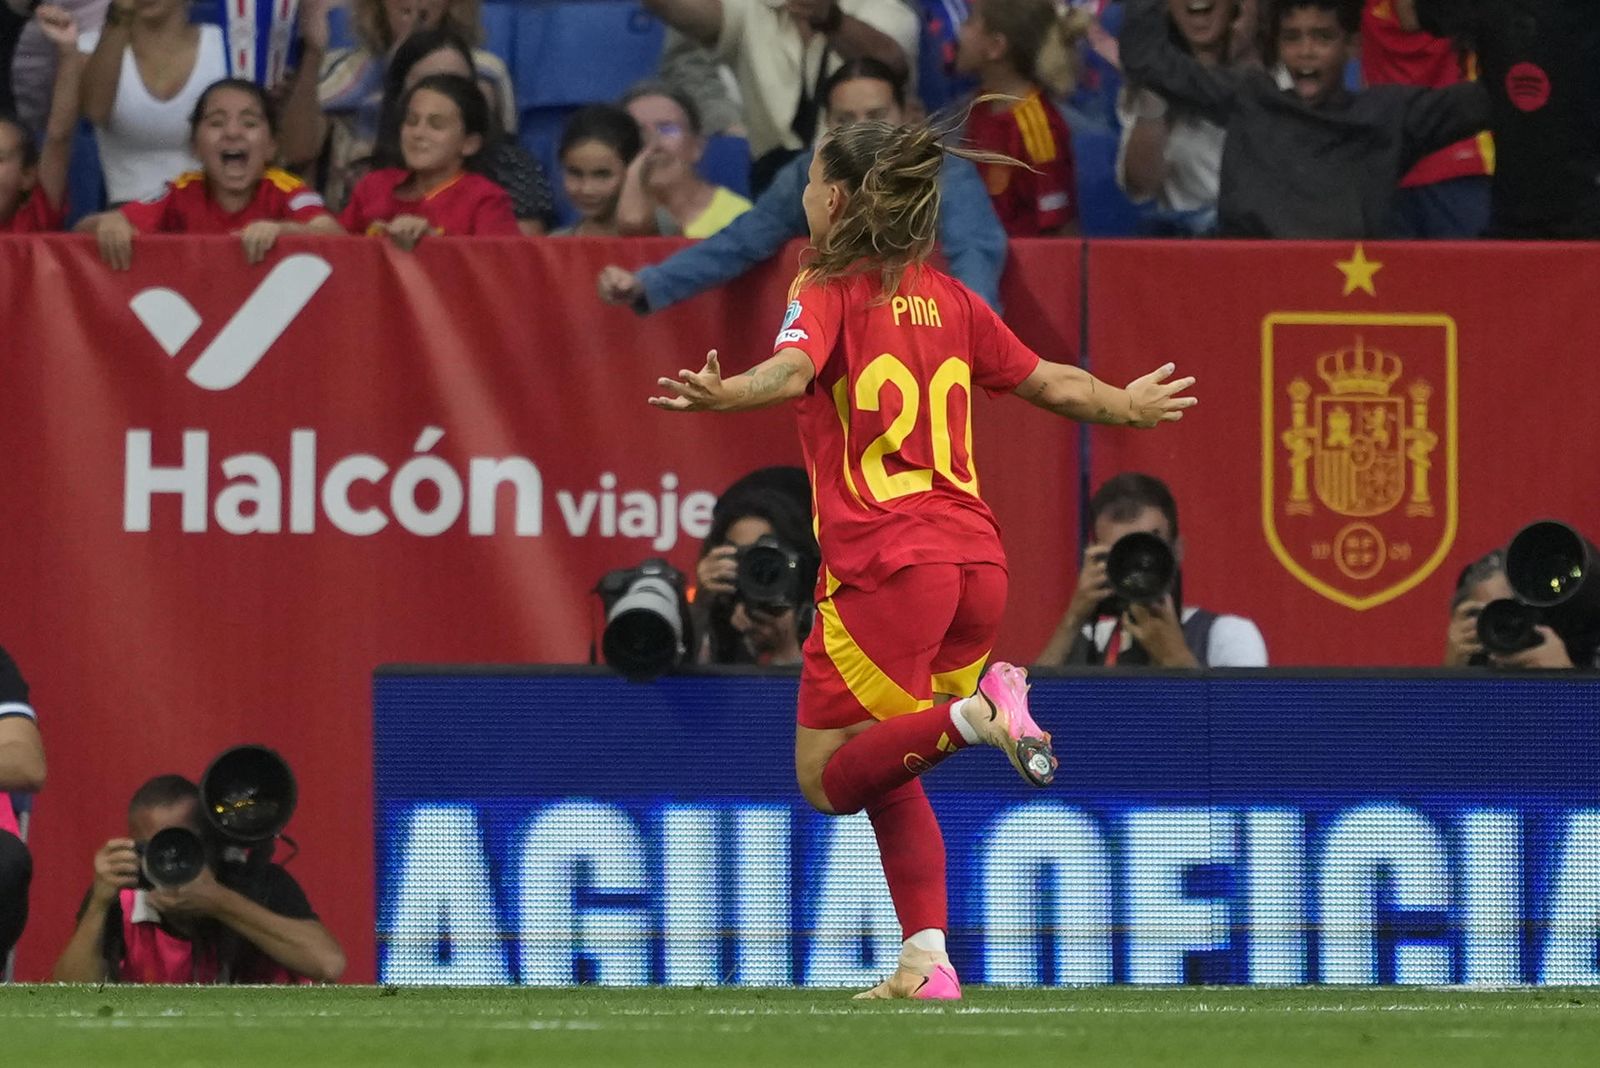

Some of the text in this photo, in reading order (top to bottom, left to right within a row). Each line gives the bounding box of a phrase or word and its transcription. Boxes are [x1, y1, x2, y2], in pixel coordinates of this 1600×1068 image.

[891, 295, 943, 328] PINA
[123, 425, 543, 536] Halcón
[855, 353, 981, 503] 20
[380, 798, 903, 987] AGUA
